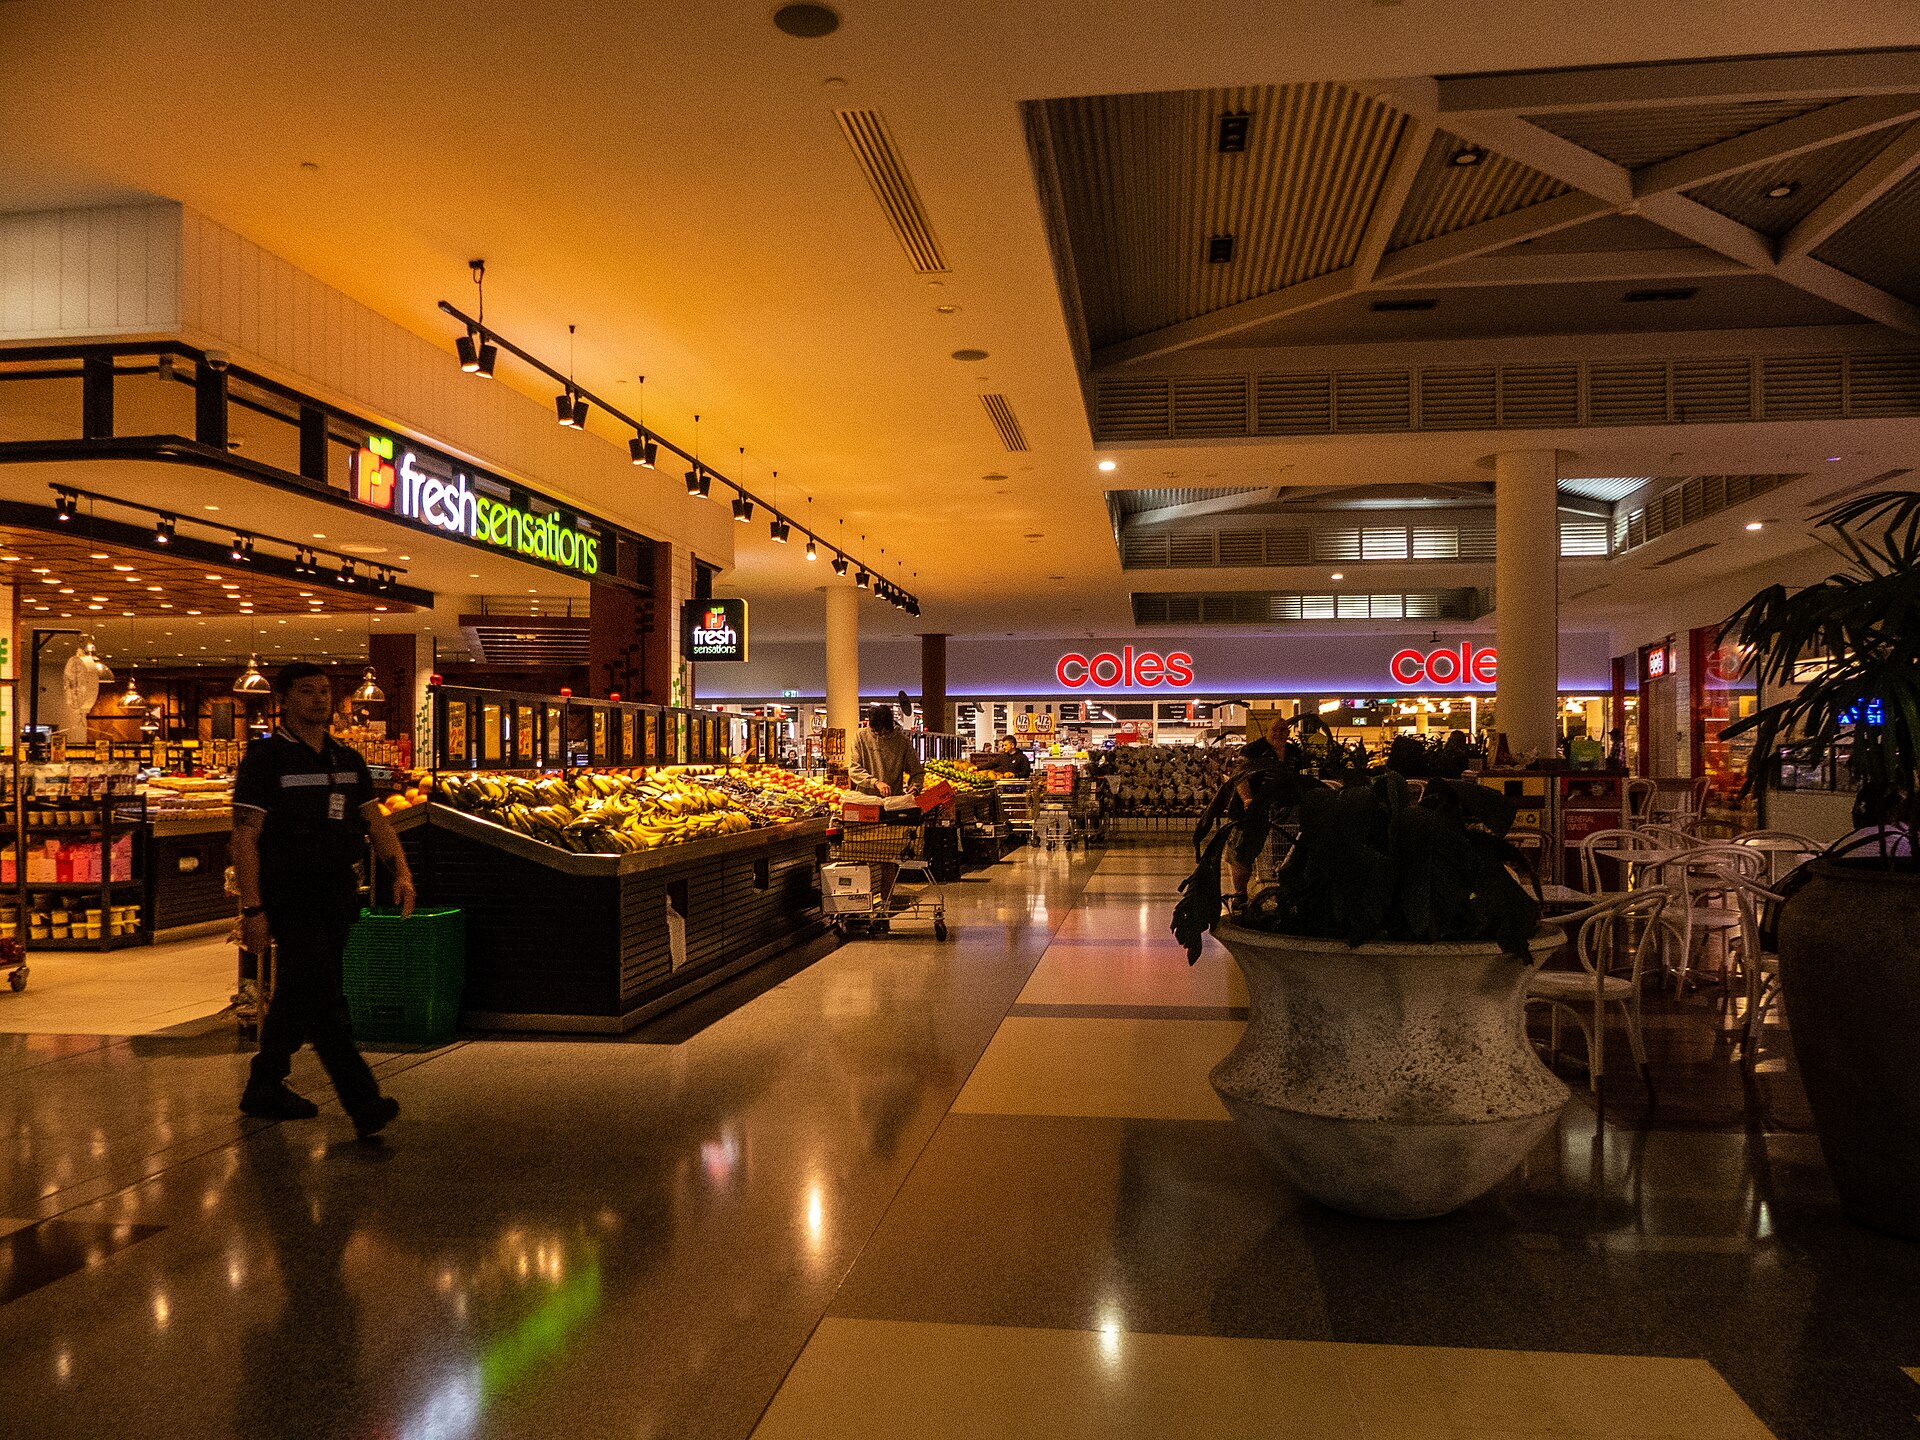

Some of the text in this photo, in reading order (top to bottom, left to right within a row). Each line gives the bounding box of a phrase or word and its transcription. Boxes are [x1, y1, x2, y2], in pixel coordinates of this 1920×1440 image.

[693, 626, 736, 645] fresh
[693, 645, 736, 654] sensations
[1056, 645, 1194, 688] coles
[1390, 641, 1496, 686] cole
